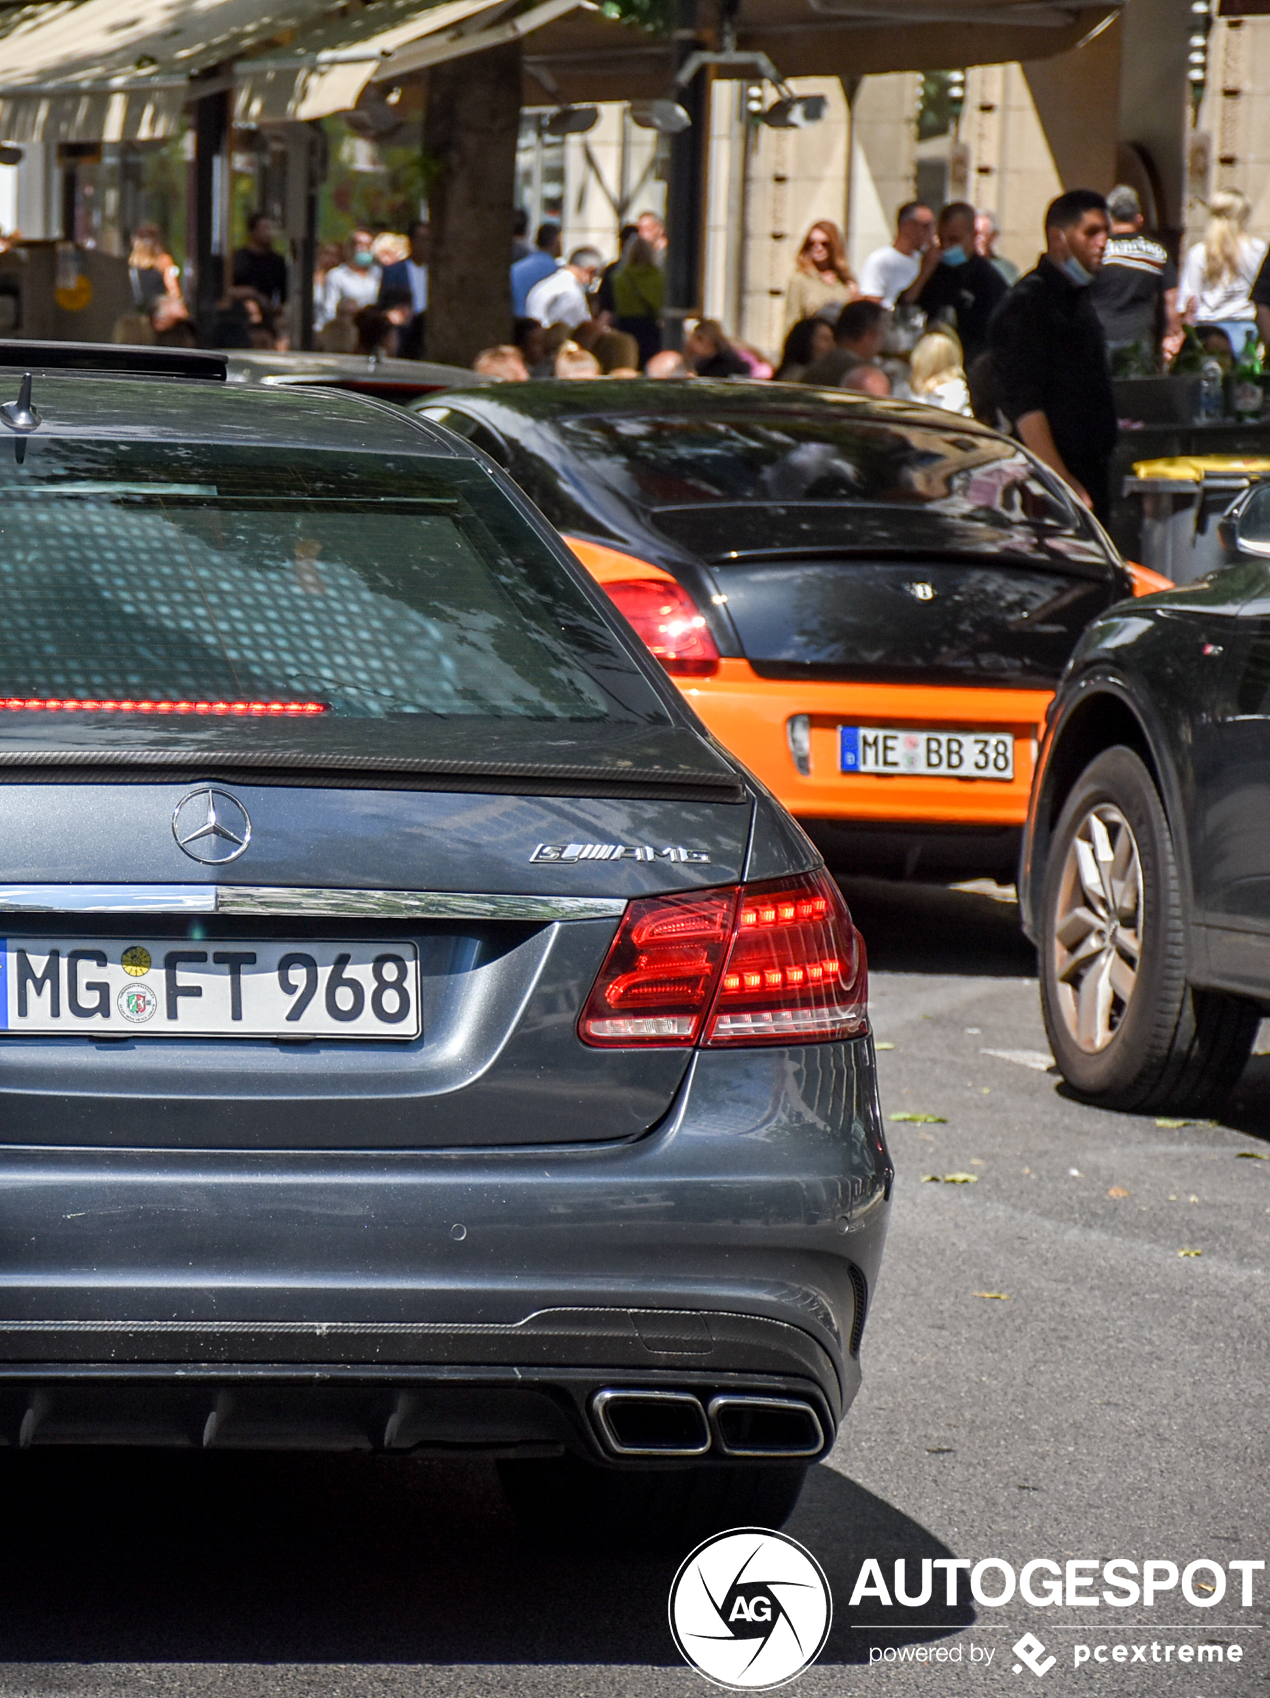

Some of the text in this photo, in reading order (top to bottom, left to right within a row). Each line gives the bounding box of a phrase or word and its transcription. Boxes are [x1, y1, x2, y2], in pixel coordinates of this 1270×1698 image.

[861, 735, 1009, 771] ME BB 38
[610, 845, 711, 863] AMG
[16, 949, 411, 1024] MG FT 968
